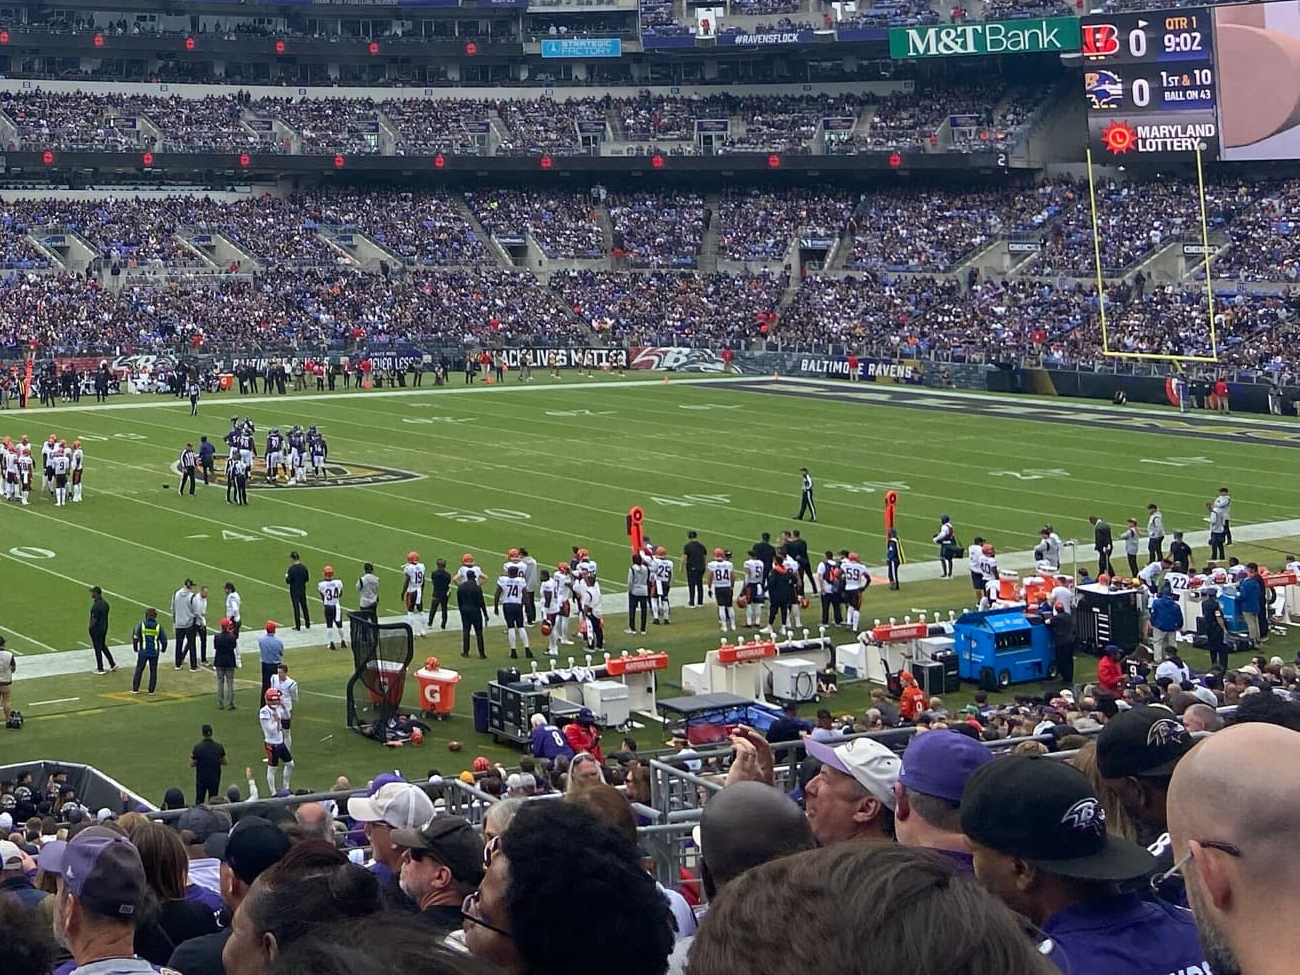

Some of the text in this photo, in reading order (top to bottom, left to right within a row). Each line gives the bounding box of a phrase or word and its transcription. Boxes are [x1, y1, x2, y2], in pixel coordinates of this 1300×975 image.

[1165, 16, 1197, 30] QTR 1
[735, 33, 798, 44] #RAVENSFLOCK
[906, 21, 1062, 56] M&T Bank
[1129, 29, 1202, 57] 0 9:02
[1160, 69, 1212, 87] 1ST & 10
[1132, 78, 1150, 107] 0
[1164, 89, 1211, 101] BALL ON 43
[1137, 124, 1215, 138] MARYLAND
[1138, 138, 1201, 152] LOTTERY
[998, 153, 1006, 166] 2
[395, 357, 415, 371] LESS
[801, 359, 913, 378] BALTIMOE RAVENS
[60, 461, 65, 471] 9
[221, 526, 308, 541] 40
[415, 571, 423, 584] 19
[658, 565, 671, 578] 25
[715, 568, 730, 581] 84
[846, 568, 860, 581] 59
[1172, 577, 1187, 590] 22
[325, 587, 339, 601] 34
[507, 585, 519, 598] 74
[1129, 666, 1137, 677] 9
[916, 701, 924, 712] 9
[551, 730, 563, 747] 8
